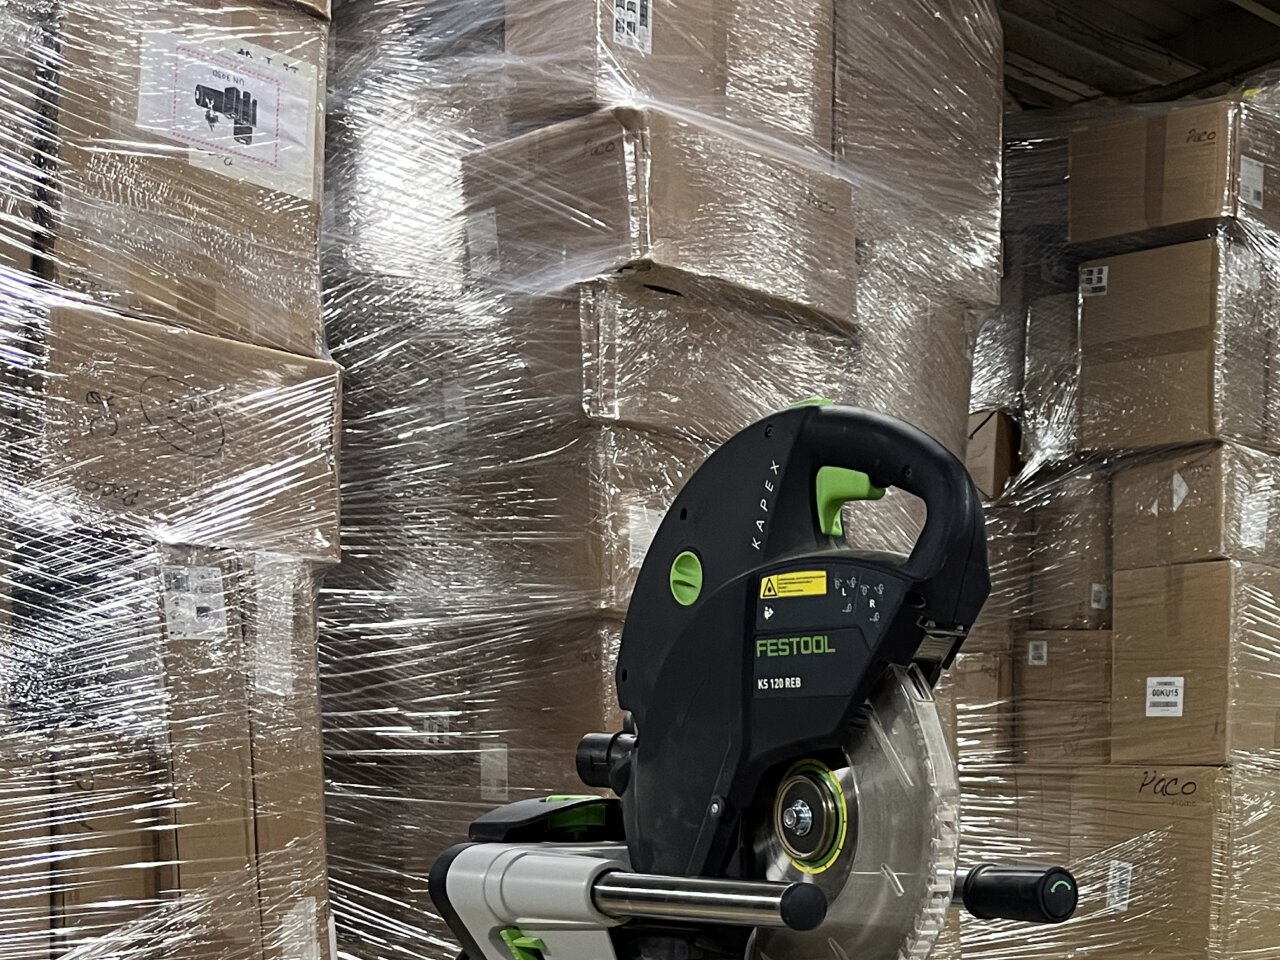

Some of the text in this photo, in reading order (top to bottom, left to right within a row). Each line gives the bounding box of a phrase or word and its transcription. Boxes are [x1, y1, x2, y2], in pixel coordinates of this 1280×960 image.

[752, 459, 780, 550] KAPEX
[841, 587, 847, 597] L
[869, 599, 876, 609] R
[756, 635, 836, 657] FESTOOL
[757, 676, 802, 690] KS 120 REB
[1138, 770, 1197, 796] Paco
